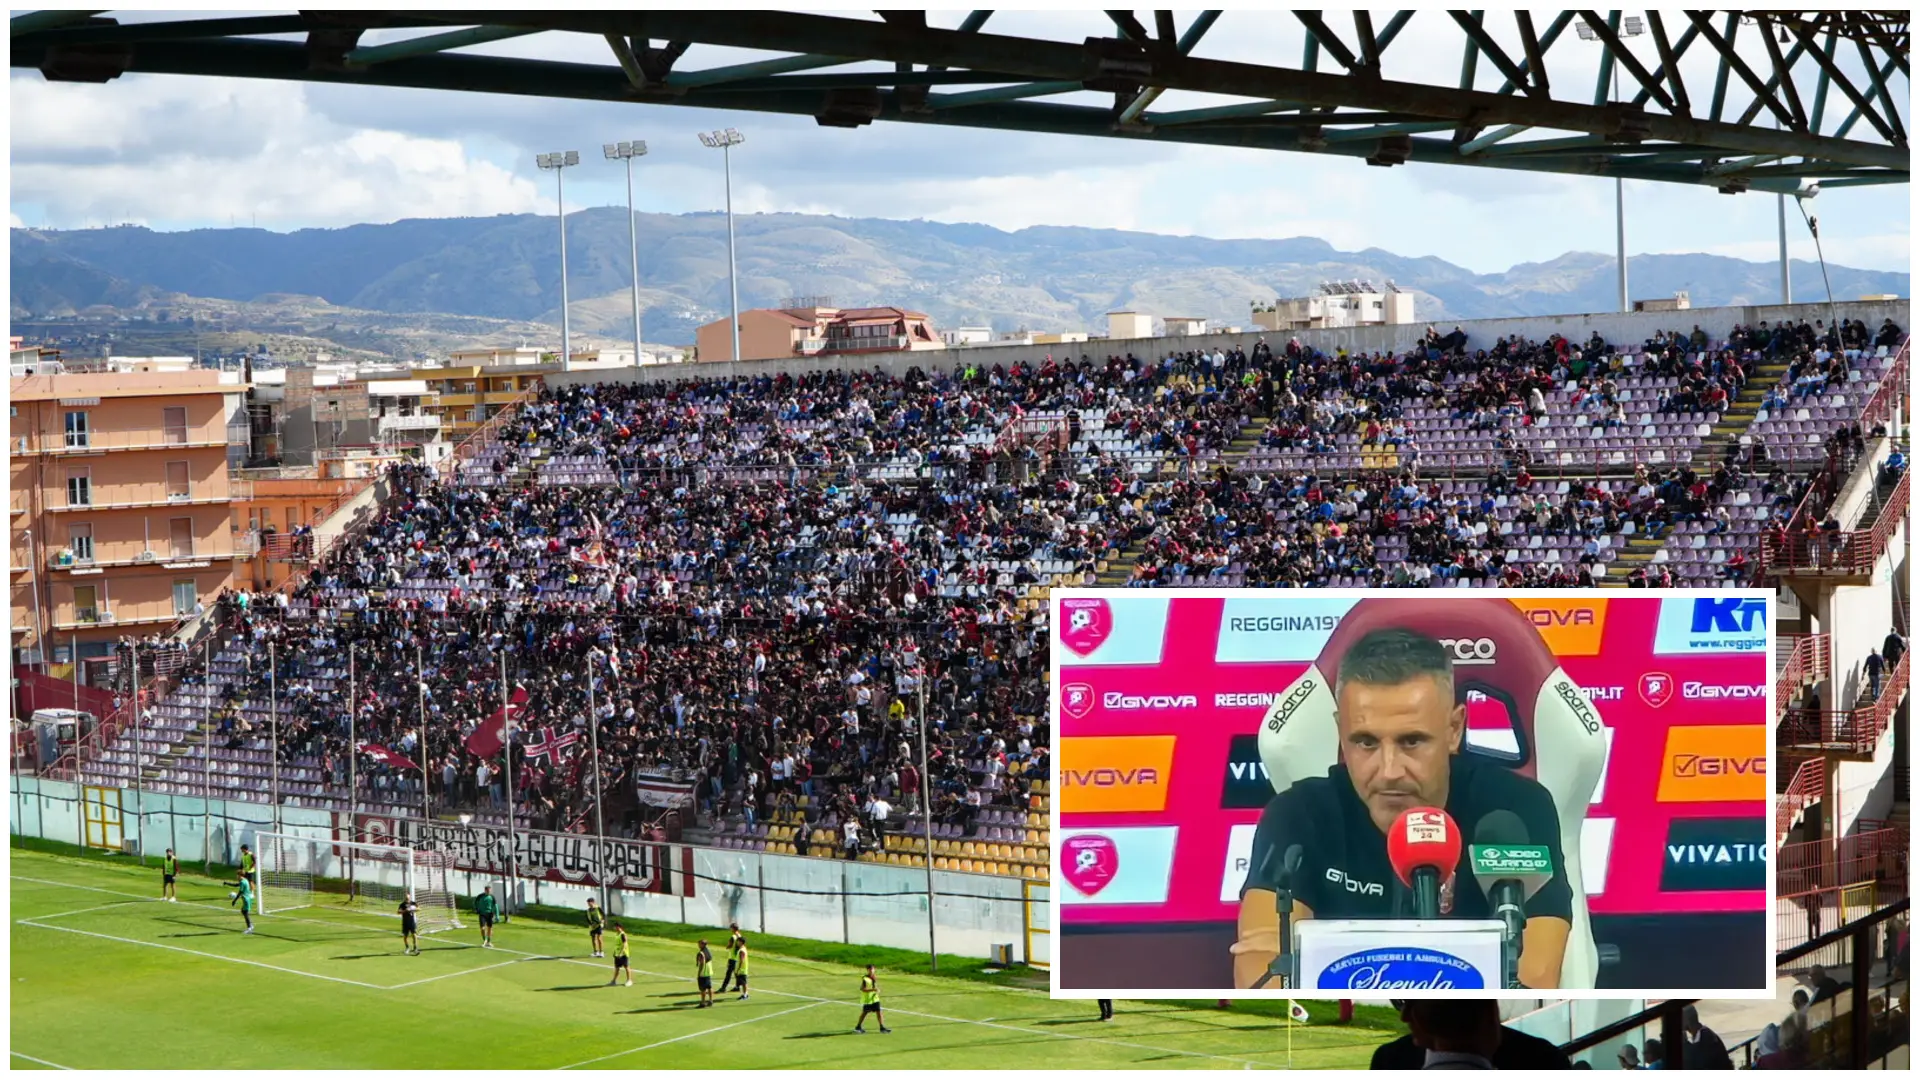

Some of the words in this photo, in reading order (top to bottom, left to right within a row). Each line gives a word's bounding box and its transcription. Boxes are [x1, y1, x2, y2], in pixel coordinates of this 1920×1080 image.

[1121, 695, 1197, 709] GIVOVA
[1268, 679, 1315, 732] sparco
[1556, 681, 1599, 734] sparco
[1060, 769, 1157, 786] IVOVA
[1503, 849, 1542, 859] VIDEO
[1477, 859, 1534, 868] TOURING
